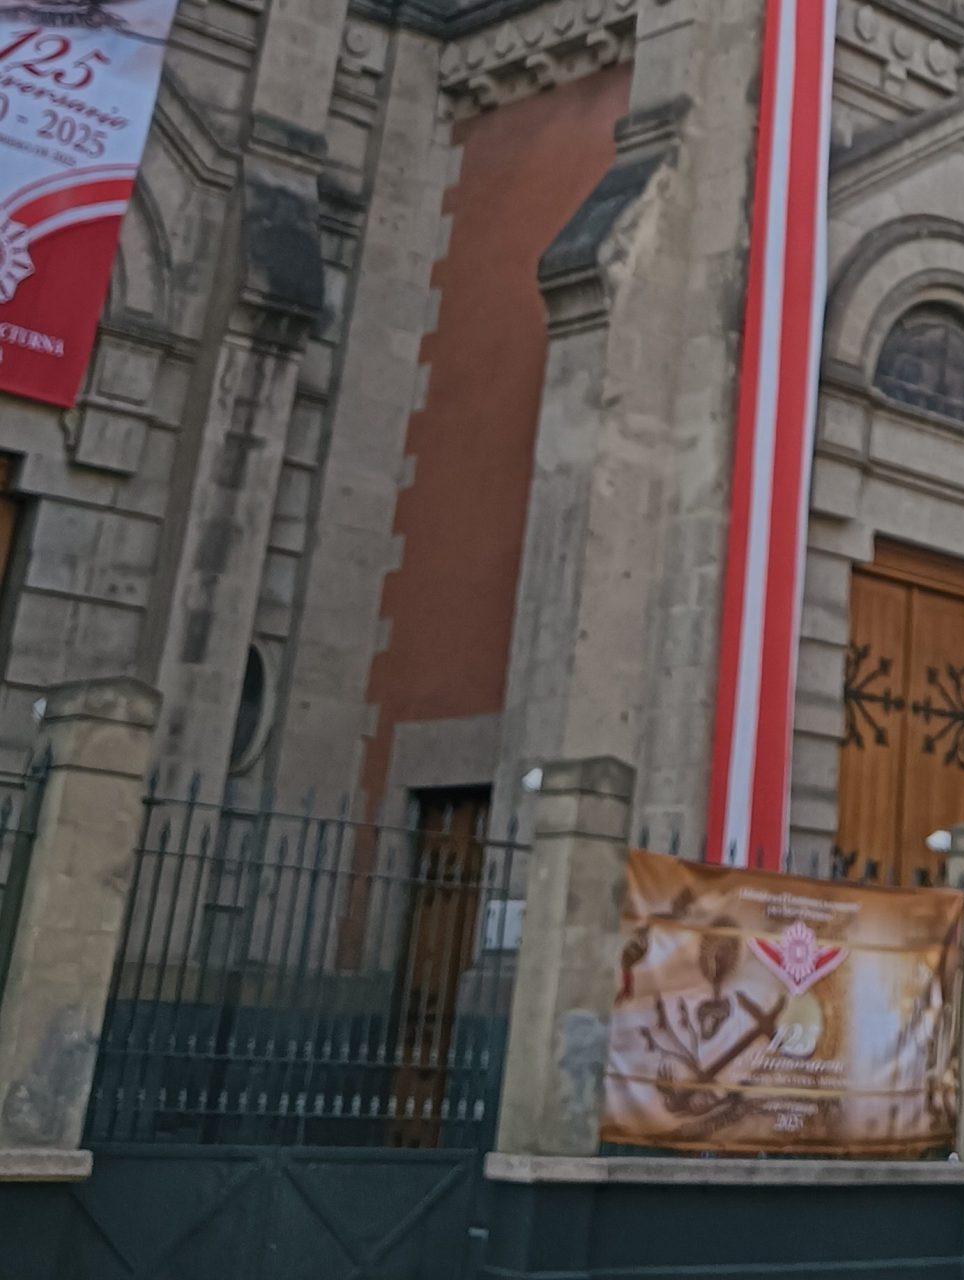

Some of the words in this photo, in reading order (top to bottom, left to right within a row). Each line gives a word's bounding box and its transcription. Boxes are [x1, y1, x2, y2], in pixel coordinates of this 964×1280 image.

[0, 26, 111, 91] 125
[0, 75, 128, 131] versario
[36, 109, 107, 158] 2025
